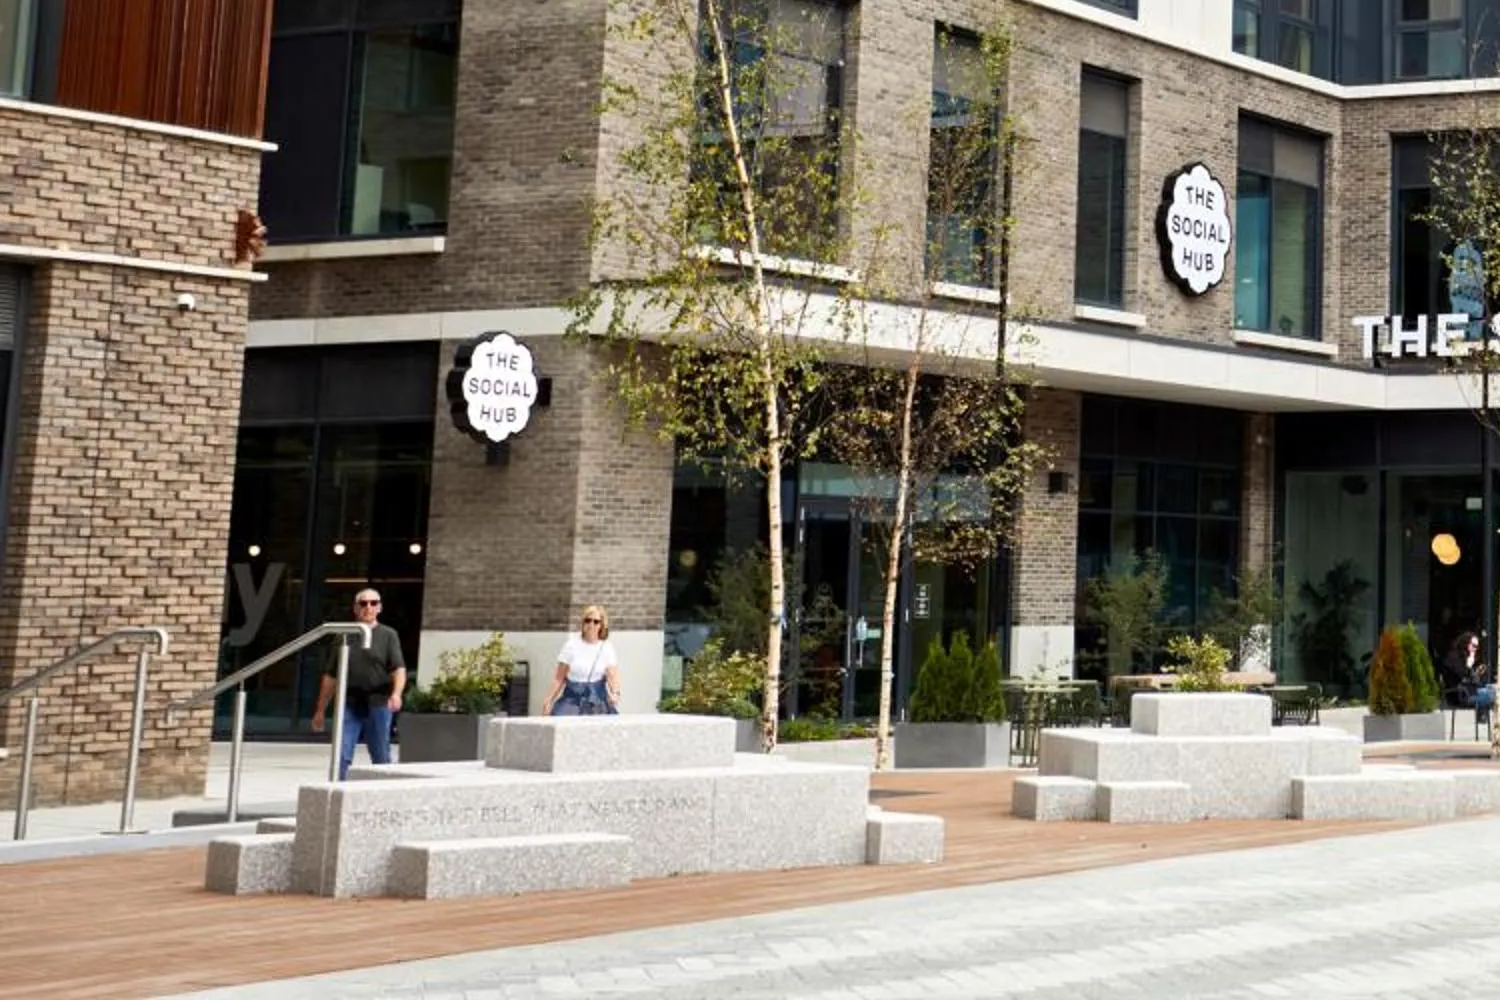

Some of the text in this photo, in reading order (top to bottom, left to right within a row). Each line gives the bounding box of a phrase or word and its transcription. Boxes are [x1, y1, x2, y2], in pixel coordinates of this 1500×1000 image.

[1185, 186, 1215, 211] THE
[1171, 214, 1226, 243] SOCIAL
[1181, 247, 1215, 271] HUB
[1352, 312, 1471, 360] THE
[486, 351, 520, 371] THE
[468, 377, 531, 398] SOCIAL
[479, 403, 517, 424] HUB
[223, 561, 286, 647] y
